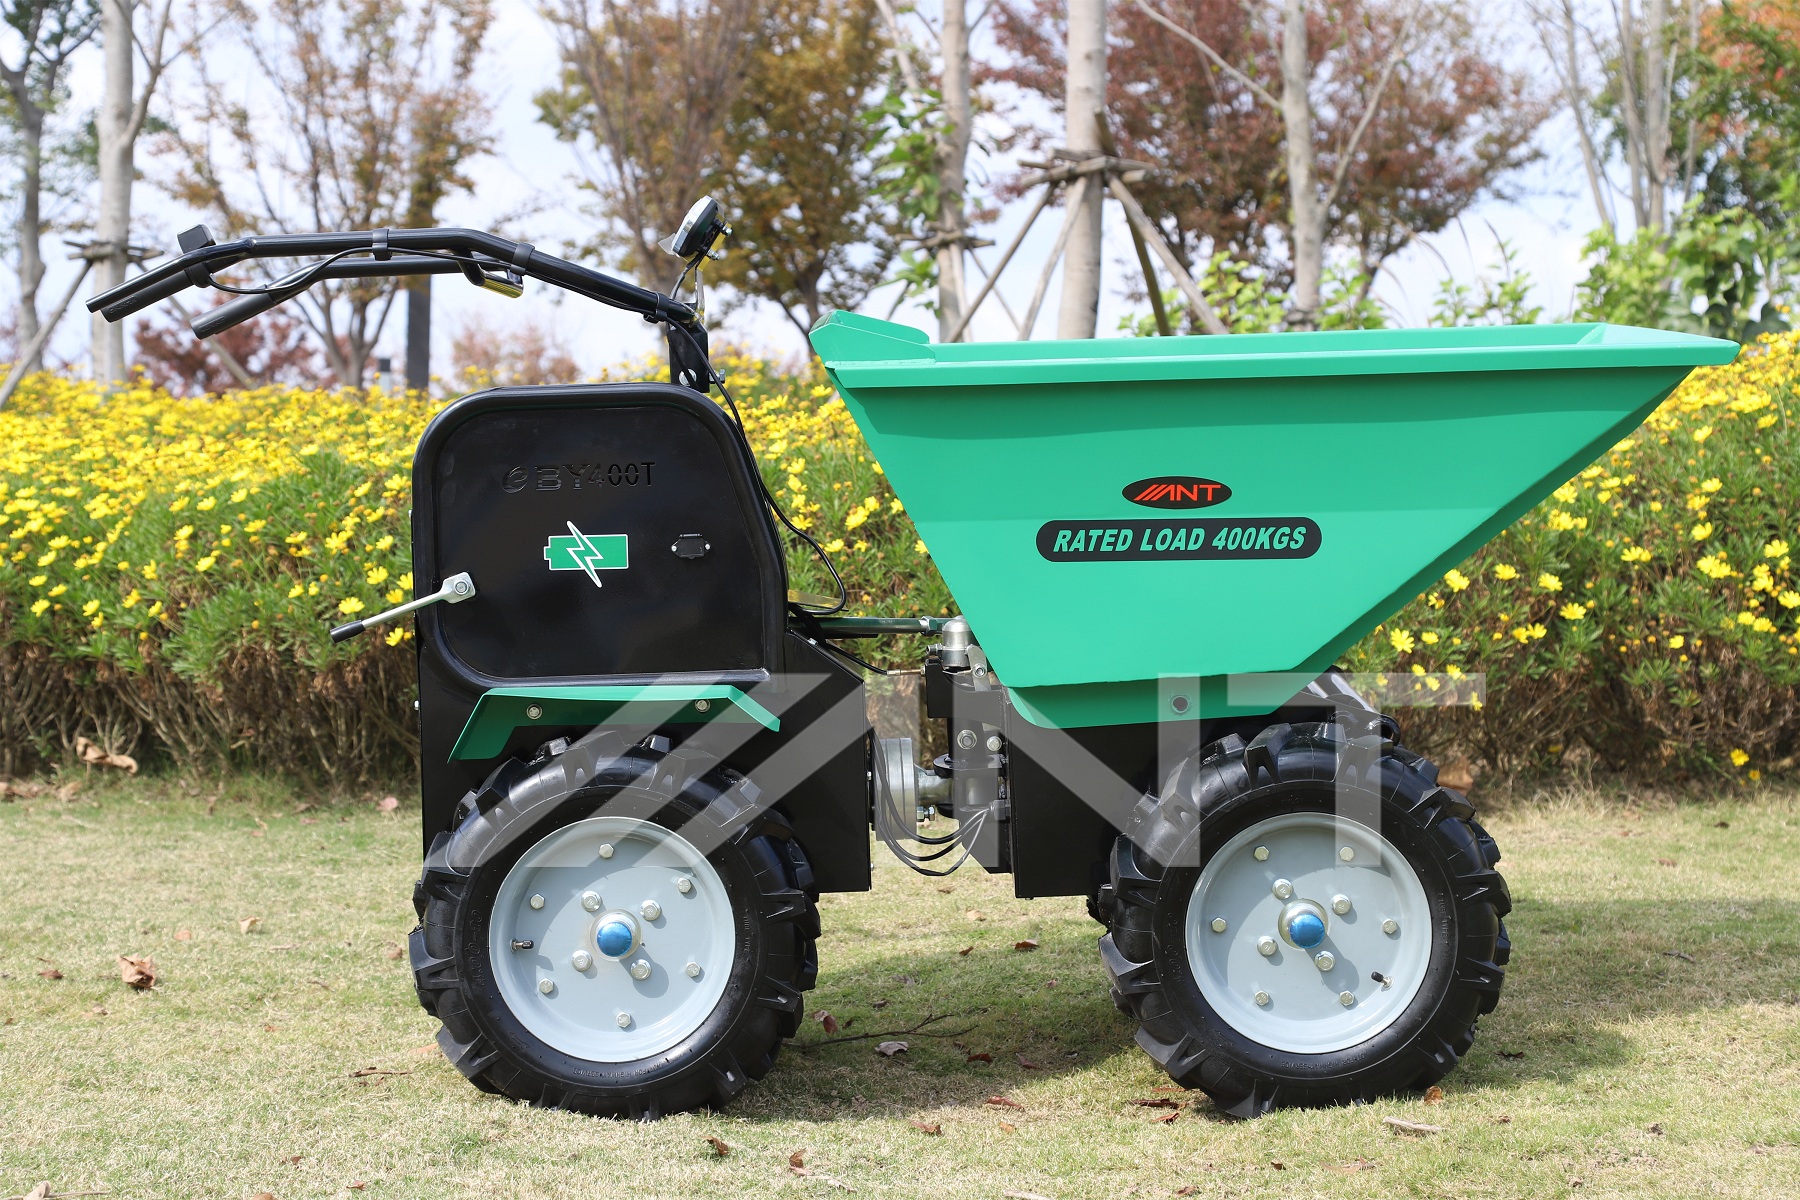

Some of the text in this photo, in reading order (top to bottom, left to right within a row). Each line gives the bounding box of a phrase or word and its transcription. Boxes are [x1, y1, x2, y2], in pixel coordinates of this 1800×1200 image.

[1134, 484, 1221, 501] ANT
[1053, 526, 1306, 552] RATED LOAD 400KGS
